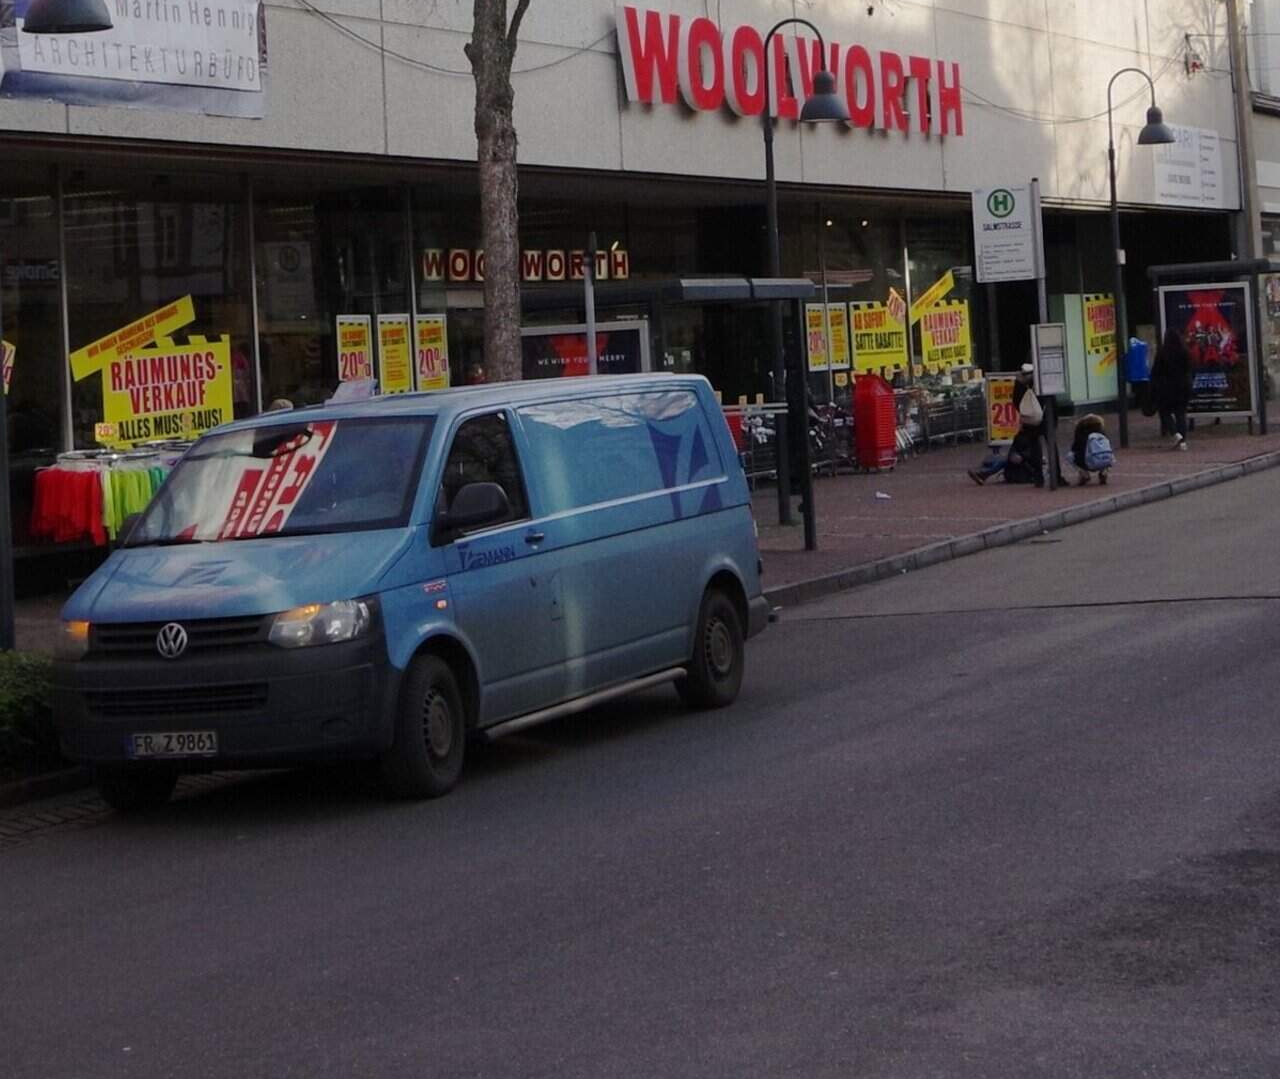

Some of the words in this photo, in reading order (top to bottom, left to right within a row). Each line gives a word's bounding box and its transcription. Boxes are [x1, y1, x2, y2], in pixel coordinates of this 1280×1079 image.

[188, 0, 255, 37] Hennig
[423, 250, 627, 278] WOWORTH
[111, 351, 223, 392] RÄUMUNGS-
[130, 379, 206, 415] VERKAUF
[119, 418, 151, 441] ALLES
